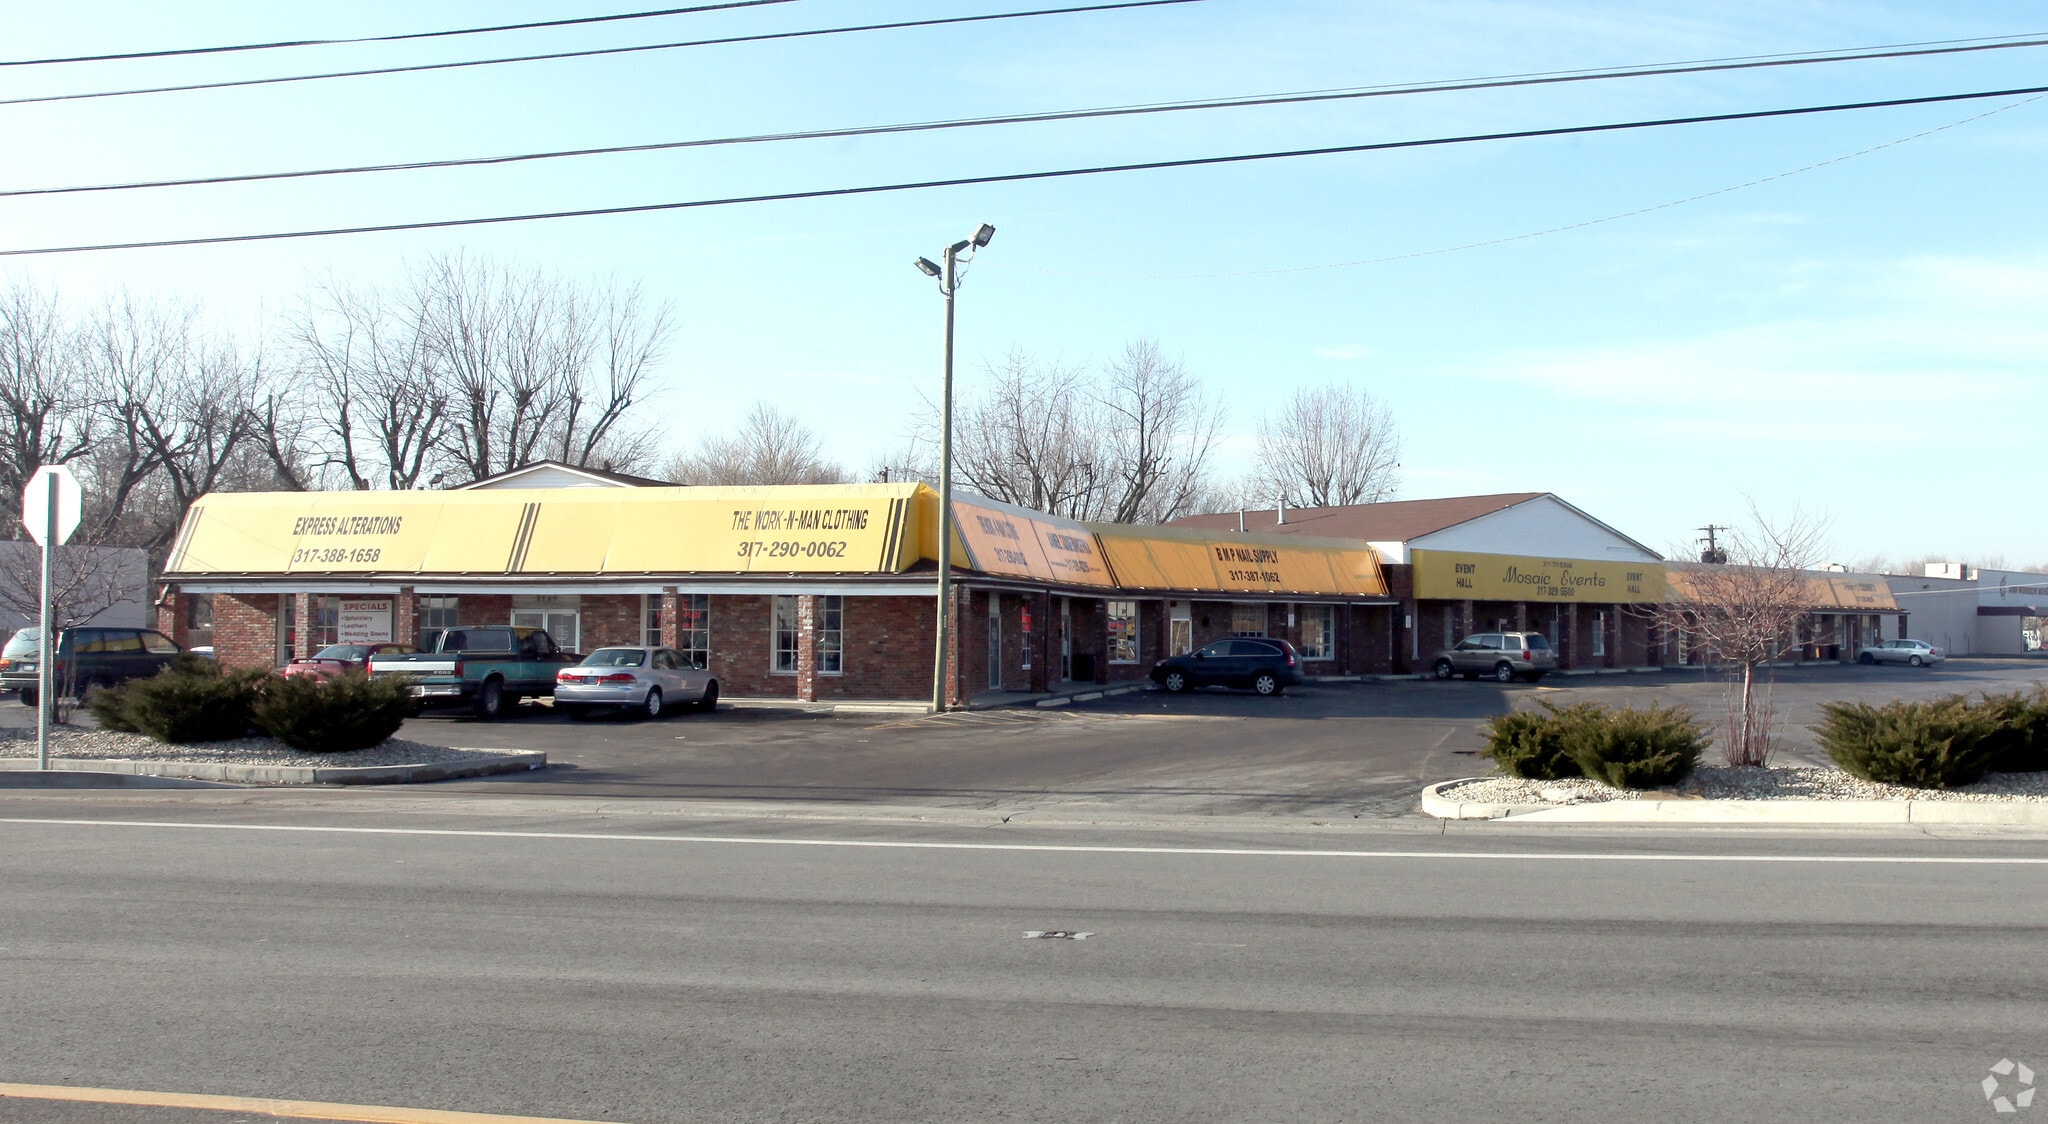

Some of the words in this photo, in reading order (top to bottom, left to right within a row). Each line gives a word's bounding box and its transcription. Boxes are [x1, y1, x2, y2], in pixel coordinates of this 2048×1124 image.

[293, 517, 337, 535] EXPRESS
[336, 516, 402, 535] ALTERATIONS
[732, 510, 752, 530] THE
[821, 509, 869, 530] CLOTHING
[294, 548, 381, 562] 317-388-1658
[737, 541, 847, 557] 317-290-0062
[1215, 547, 1223, 561] B
[1222, 547, 1231, 561] M
[1229, 548, 1236, 561] P
[1235, 548, 1254, 562] NAIL
[1252, 549, 1279, 563] SUPPLY
[1455, 563, 1475, 574] EVENT
[1229, 570, 1280, 582] 317-387-1062
[1456, 577, 1473, 588] HALL
[1502, 566, 1551, 585] Mosaic
[1560, 569, 1606, 587] Events
[1626, 572, 1643, 581] EVENT
[343, 603, 388, 611] SPECIALS
